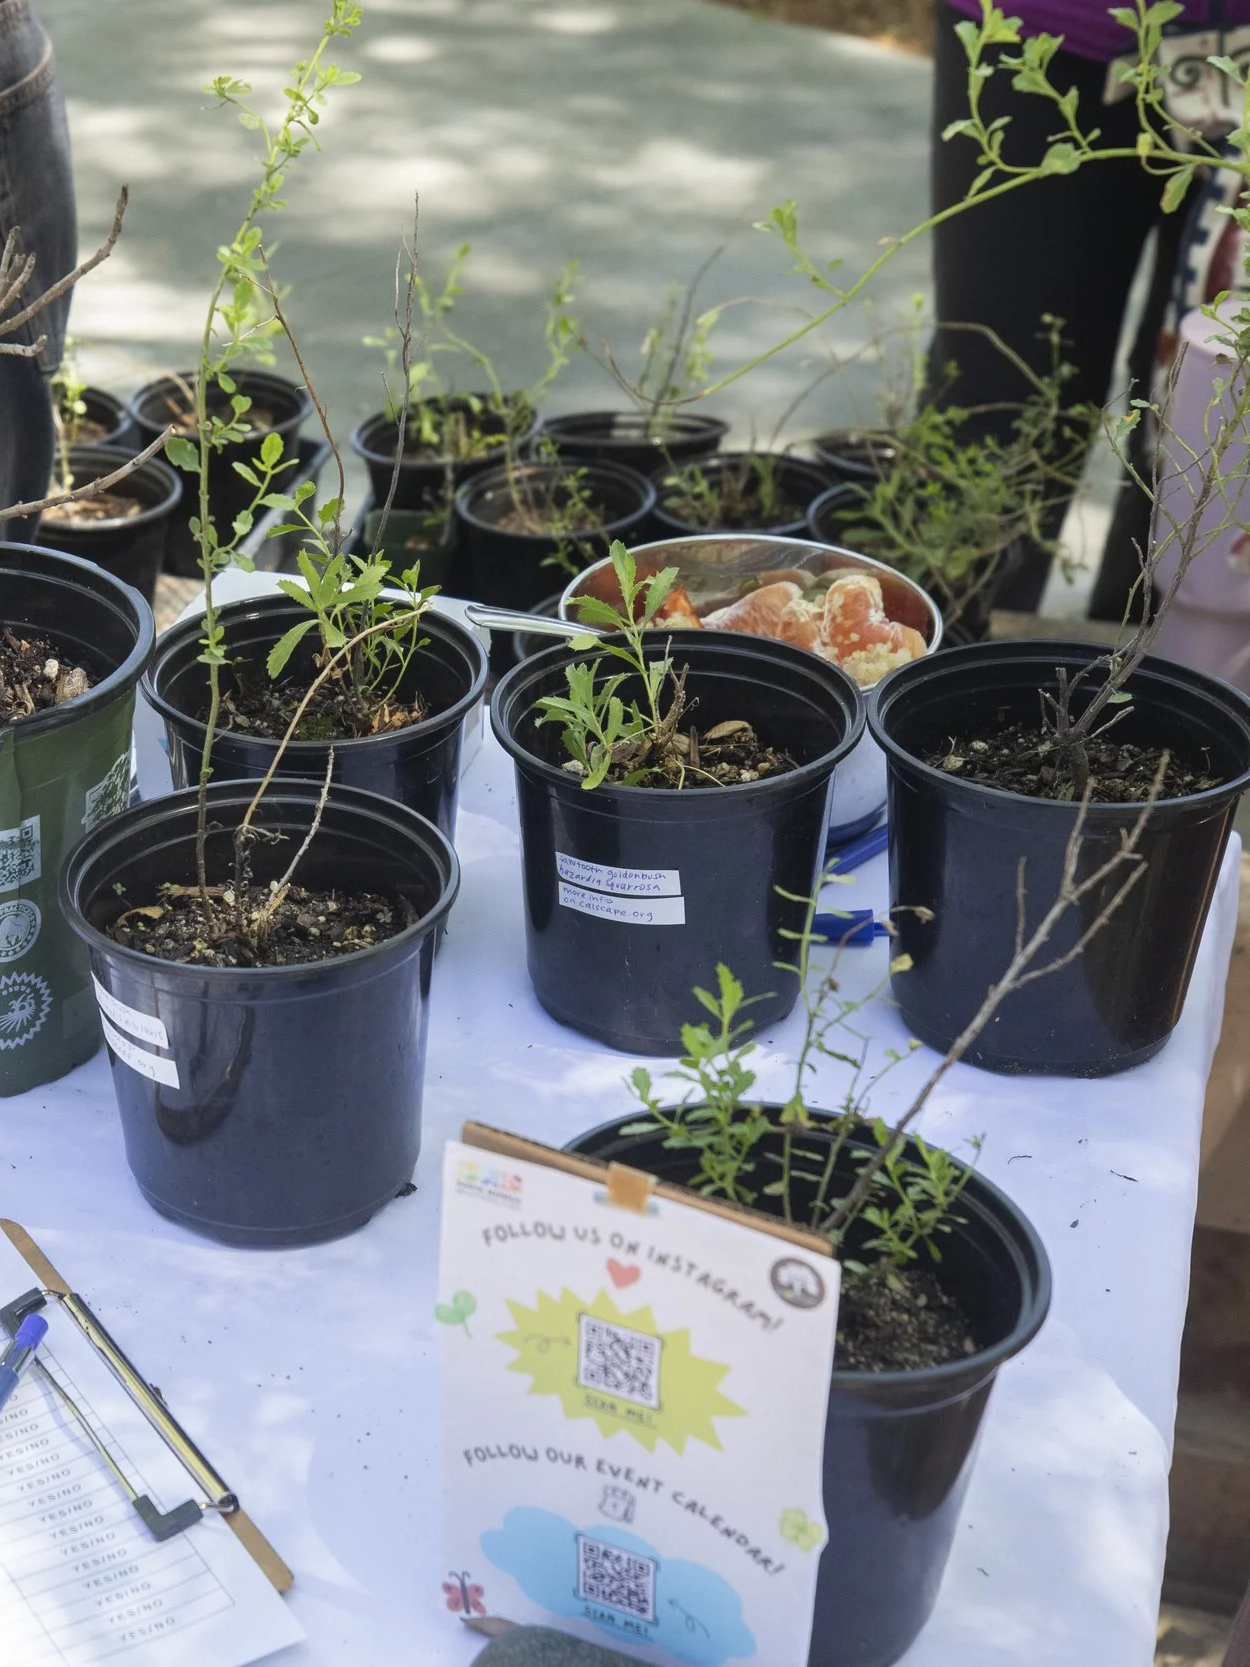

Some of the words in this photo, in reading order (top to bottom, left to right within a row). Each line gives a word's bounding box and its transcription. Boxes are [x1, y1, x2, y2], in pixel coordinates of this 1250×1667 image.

[563, 886, 586, 899] more
[590, 895, 613, 904] info
[482, 1219, 566, 1248] FOLLOW
[574, 1223, 602, 1245] US
[610, 1231, 640, 1257] ON
[647, 1245, 786, 1335] INSTAGRAM!
[7, 1453, 60, 1477] YES/NO
[17, 1468, 71, 1492] YES/NO
[27, 1483, 82, 1507] YES/NO
[38, 1499, 93, 1523] YES/NO
[463, 1443, 539, 1467] FOLLOW
[545, 1446, 587, 1472] OUR
[595, 1458, 664, 1494] EVENT
[671, 1490, 787, 1578] CALENDAR!
[50, 1515, 104, 1539] YES/NO
[60, 1531, 115, 1556] YES/NO
[71, 1548, 127, 1573] YES/NO
[83, 1564, 139, 1589] YES/NO
[95, 1581, 151, 1607] YES/NO
[106, 1598, 163, 1624] YES/NO
[118, 1616, 176, 1642] YES/NO
